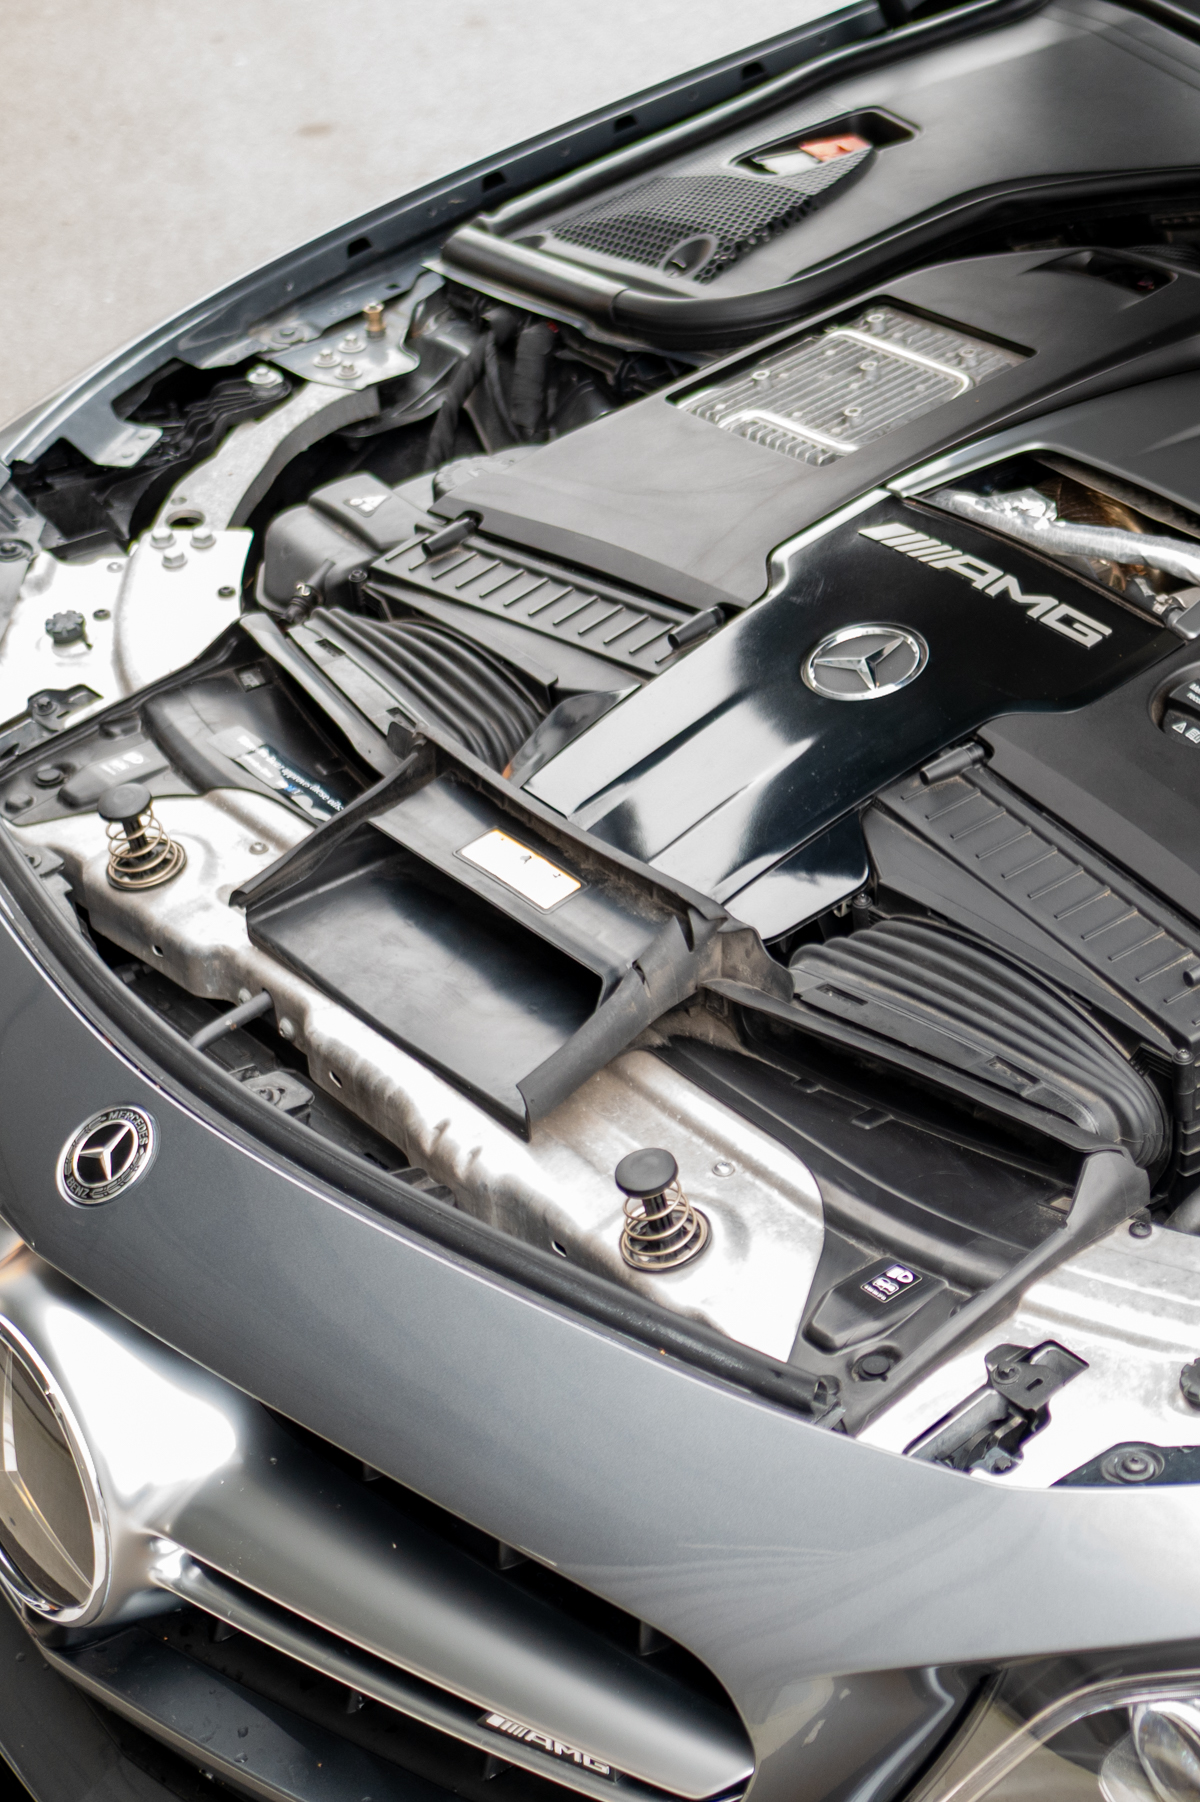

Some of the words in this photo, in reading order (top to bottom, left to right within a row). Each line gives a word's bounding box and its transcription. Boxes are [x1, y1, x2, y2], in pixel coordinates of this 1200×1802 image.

[927, 554, 1113, 650] AMG
[108, 1110, 149, 1146] MERCEDES
[66, 1176, 90, 1199] BENZ
[524, 1730, 611, 1775] AMG
